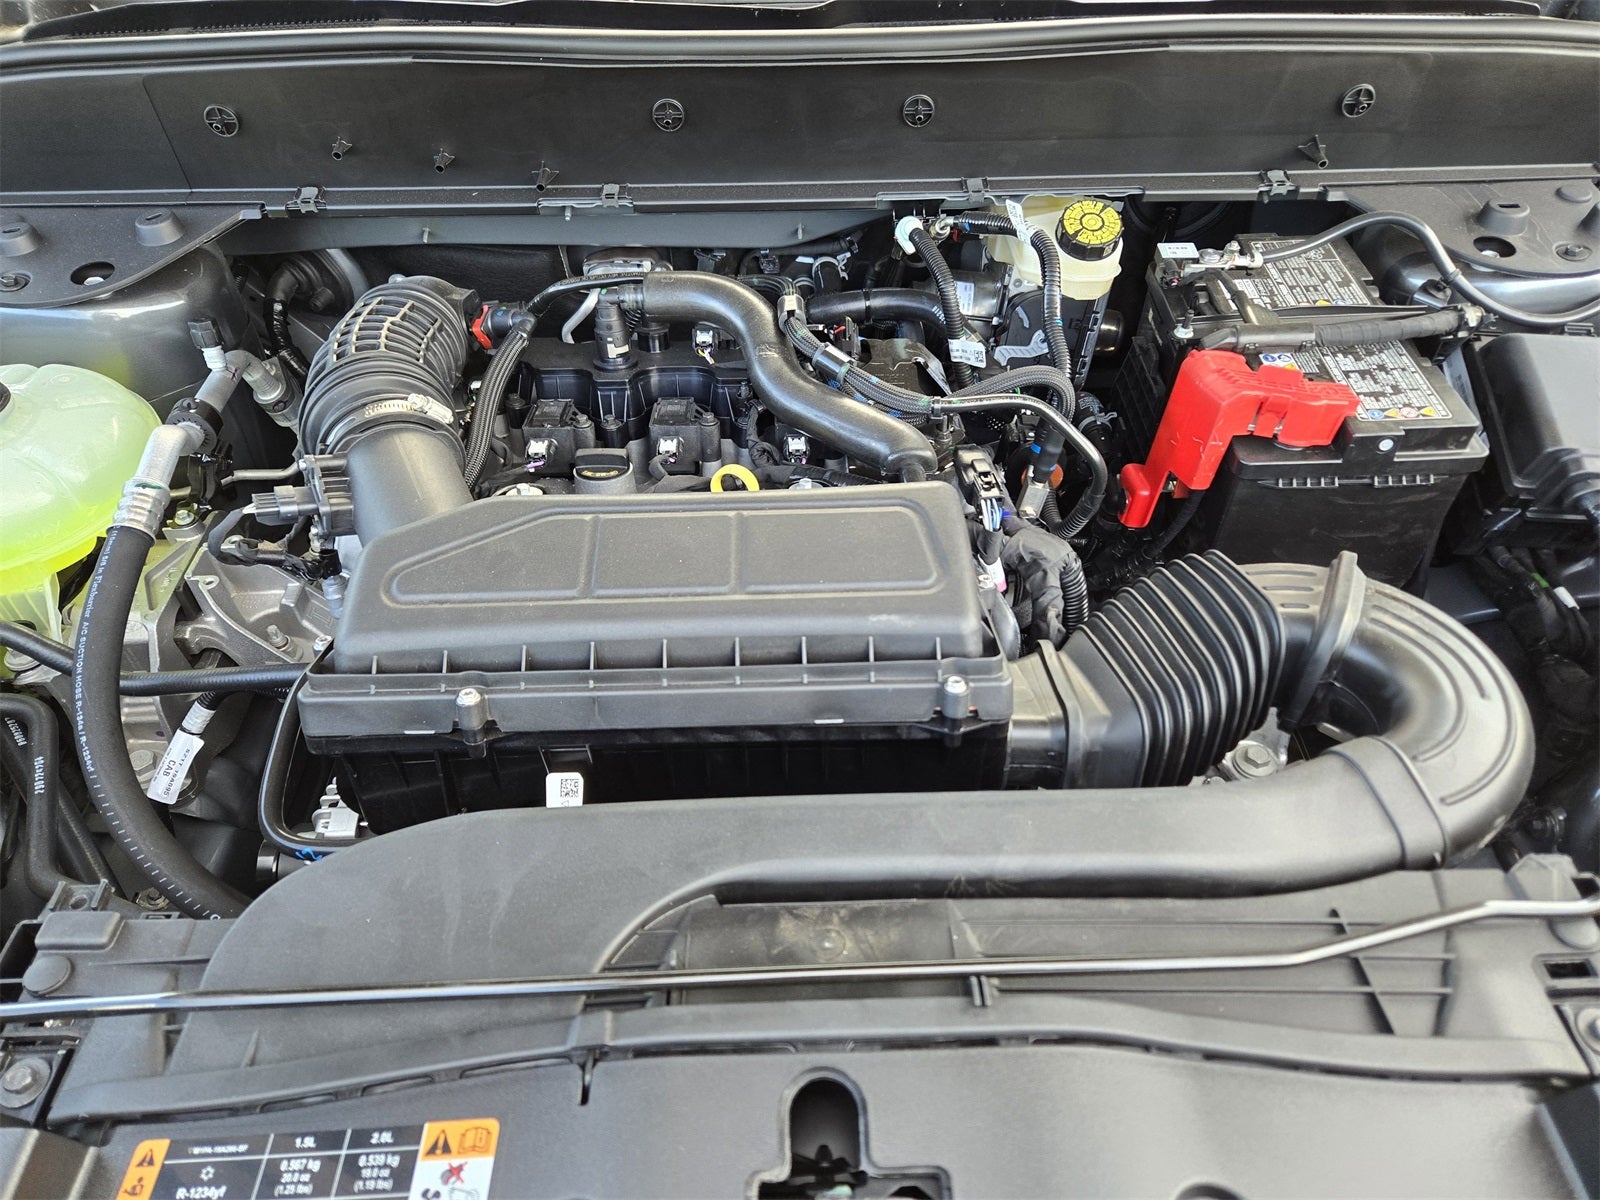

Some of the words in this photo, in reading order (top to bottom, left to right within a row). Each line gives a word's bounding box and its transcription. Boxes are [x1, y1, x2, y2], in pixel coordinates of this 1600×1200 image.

[81, 621, 90, 635] A/C
[76, 636, 87, 675] SUCTION
[75, 675, 83, 700] HOSE
[162, 759, 176, 777] CAB
[175, 1185, 227, 1200] R-1234yf
